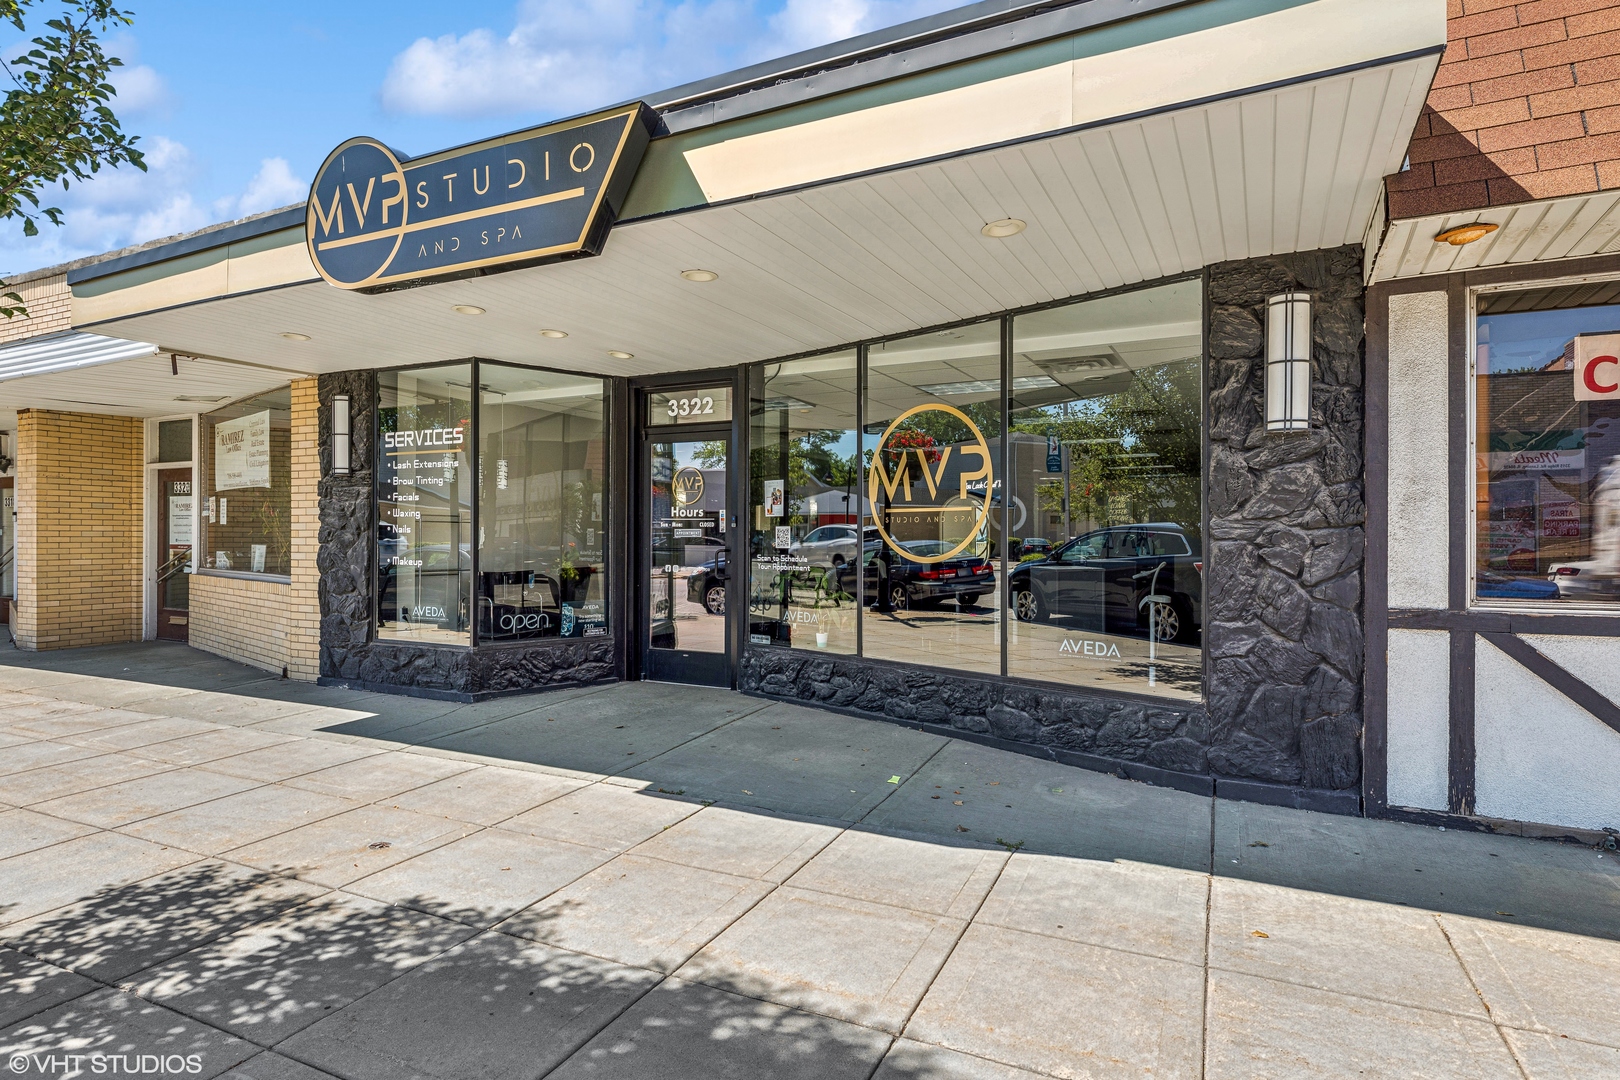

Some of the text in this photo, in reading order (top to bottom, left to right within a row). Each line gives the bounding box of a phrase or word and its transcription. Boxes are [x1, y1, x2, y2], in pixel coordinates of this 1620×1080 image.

[416, 142, 596, 208] STUDIO
[311, 172, 406, 239] MVP
[418, 225, 522, 257] AND SPA
[667, 396, 714, 417] 3322
[221, 429, 245, 446] RAMIREZ
[384, 427, 464, 448] SERVICES
[392, 459, 459, 470] Lash Extensions
[870, 444, 991, 503] MVP
[392, 475, 444, 487] Brow Tinting
[672, 476, 703, 490] MVP
[392, 492, 420, 502] Facials
[392, 508, 421, 520] Waxing
[671, 506, 704, 518] Hours
[885, 516, 920, 524] STUDIO
[392, 524, 412, 534] Nails
[392, 556, 423, 568] Makeup
[780, 554, 808, 563] Schedule
[772, 563, 811, 572] Appointment
[412, 605, 446, 618] AVEDA
[783, 610, 819, 624] AVEDA
[500, 613, 549, 634] open
[1059, 638, 1121, 659] AVEDA
